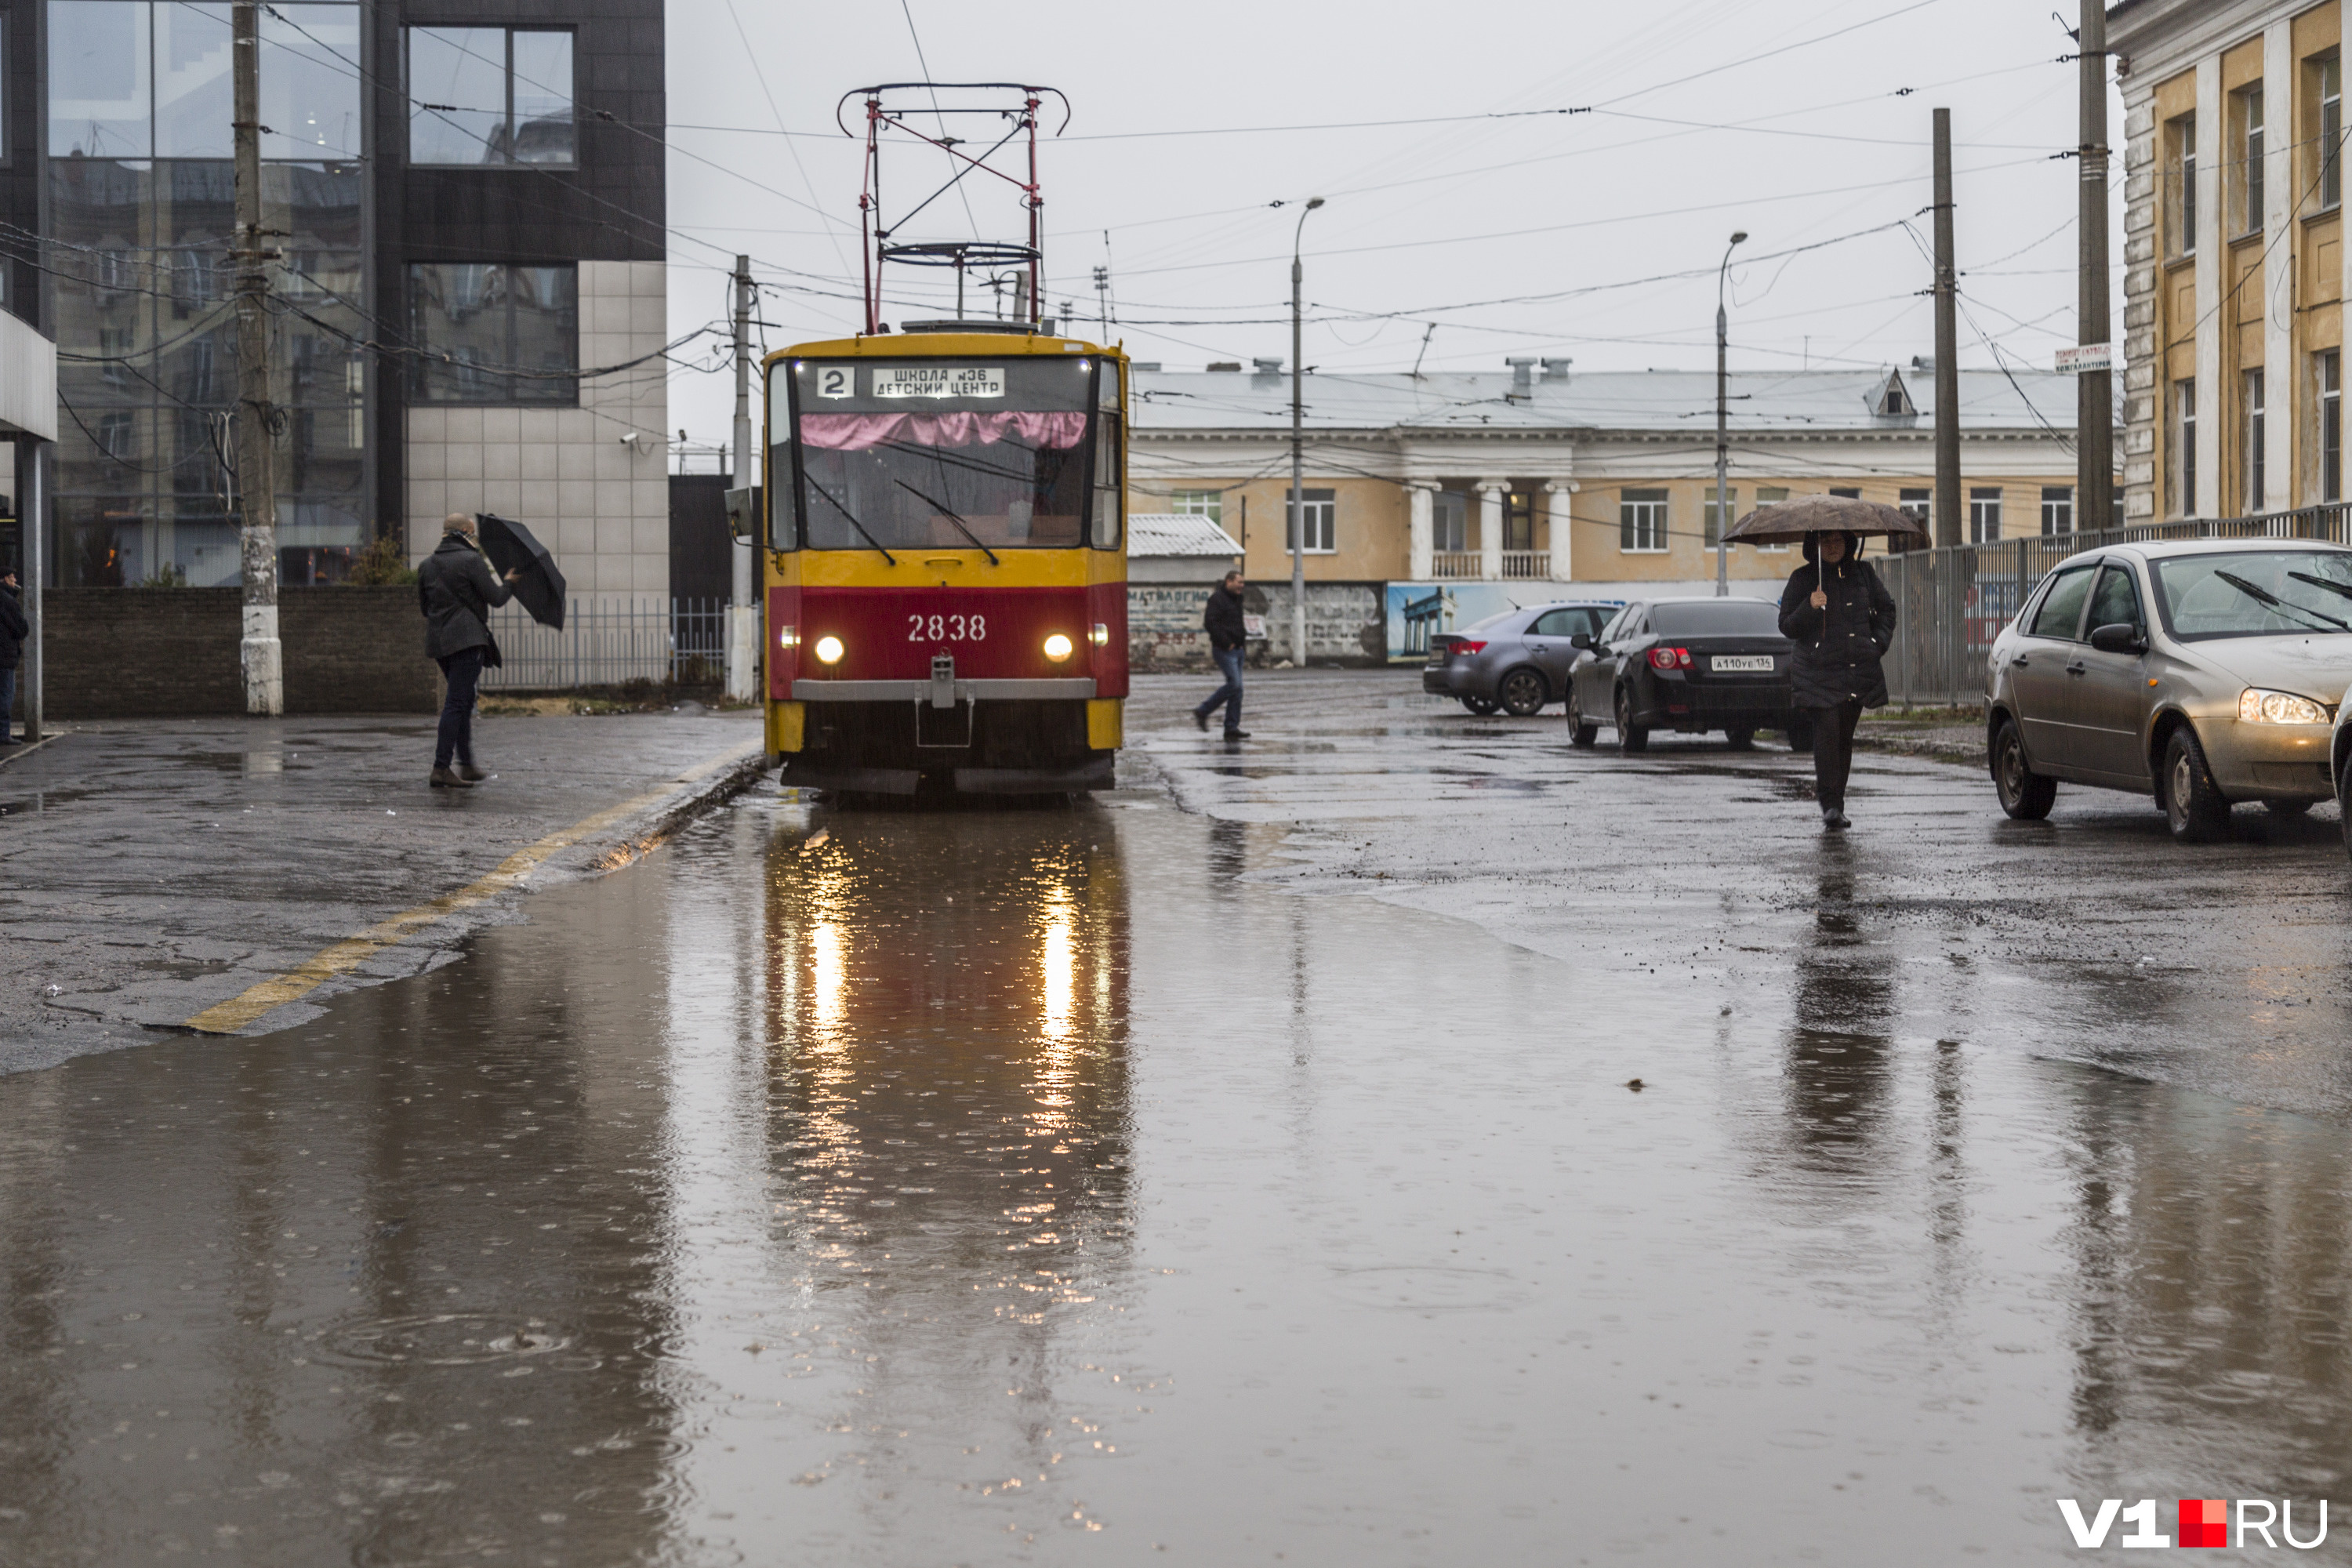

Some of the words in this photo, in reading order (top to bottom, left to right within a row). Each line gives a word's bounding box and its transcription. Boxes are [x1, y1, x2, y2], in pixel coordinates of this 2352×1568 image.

[825, 370, 844, 394] 2
[895, 370, 948, 381] ШКОЛА
[951, 382, 999, 396] ЦЕНТР
[908, 614, 986, 641] 2838
